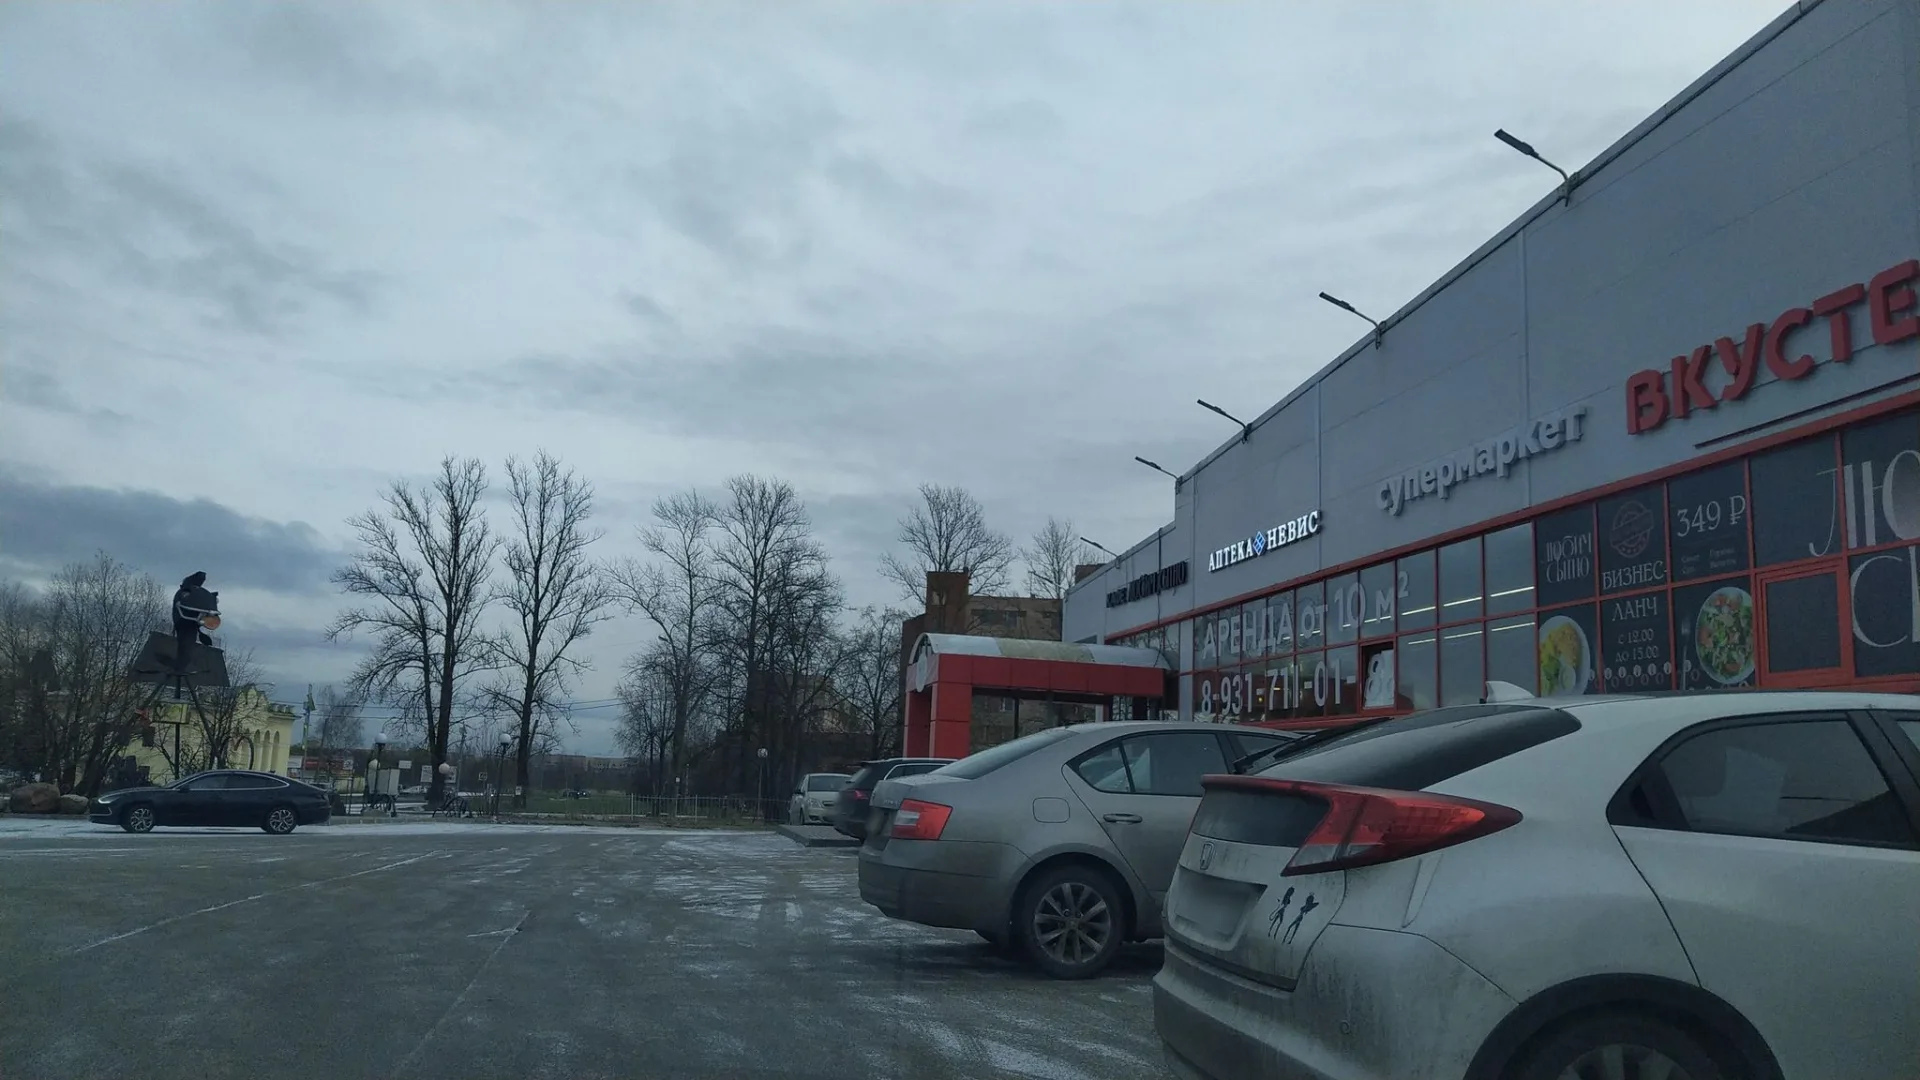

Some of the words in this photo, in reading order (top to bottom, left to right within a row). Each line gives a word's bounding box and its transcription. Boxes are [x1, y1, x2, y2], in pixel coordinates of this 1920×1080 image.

[1376, 405, 1588, 517] супермаркет
[1676, 500, 1721, 537] 349
[1208, 537, 1253, 572] АПТЕКА
[1266, 510, 1320, 550] НЕВИС
[1203, 602, 1294, 660] АРЕНДА
[1335, 582, 1367, 632] 10
[1611, 597, 1658, 622] ЛАНЧ
[1615, 650, 1630, 663] до
[1632, 645, 1660, 660] 15.00
[1627, 628, 1655, 644] 12.00
